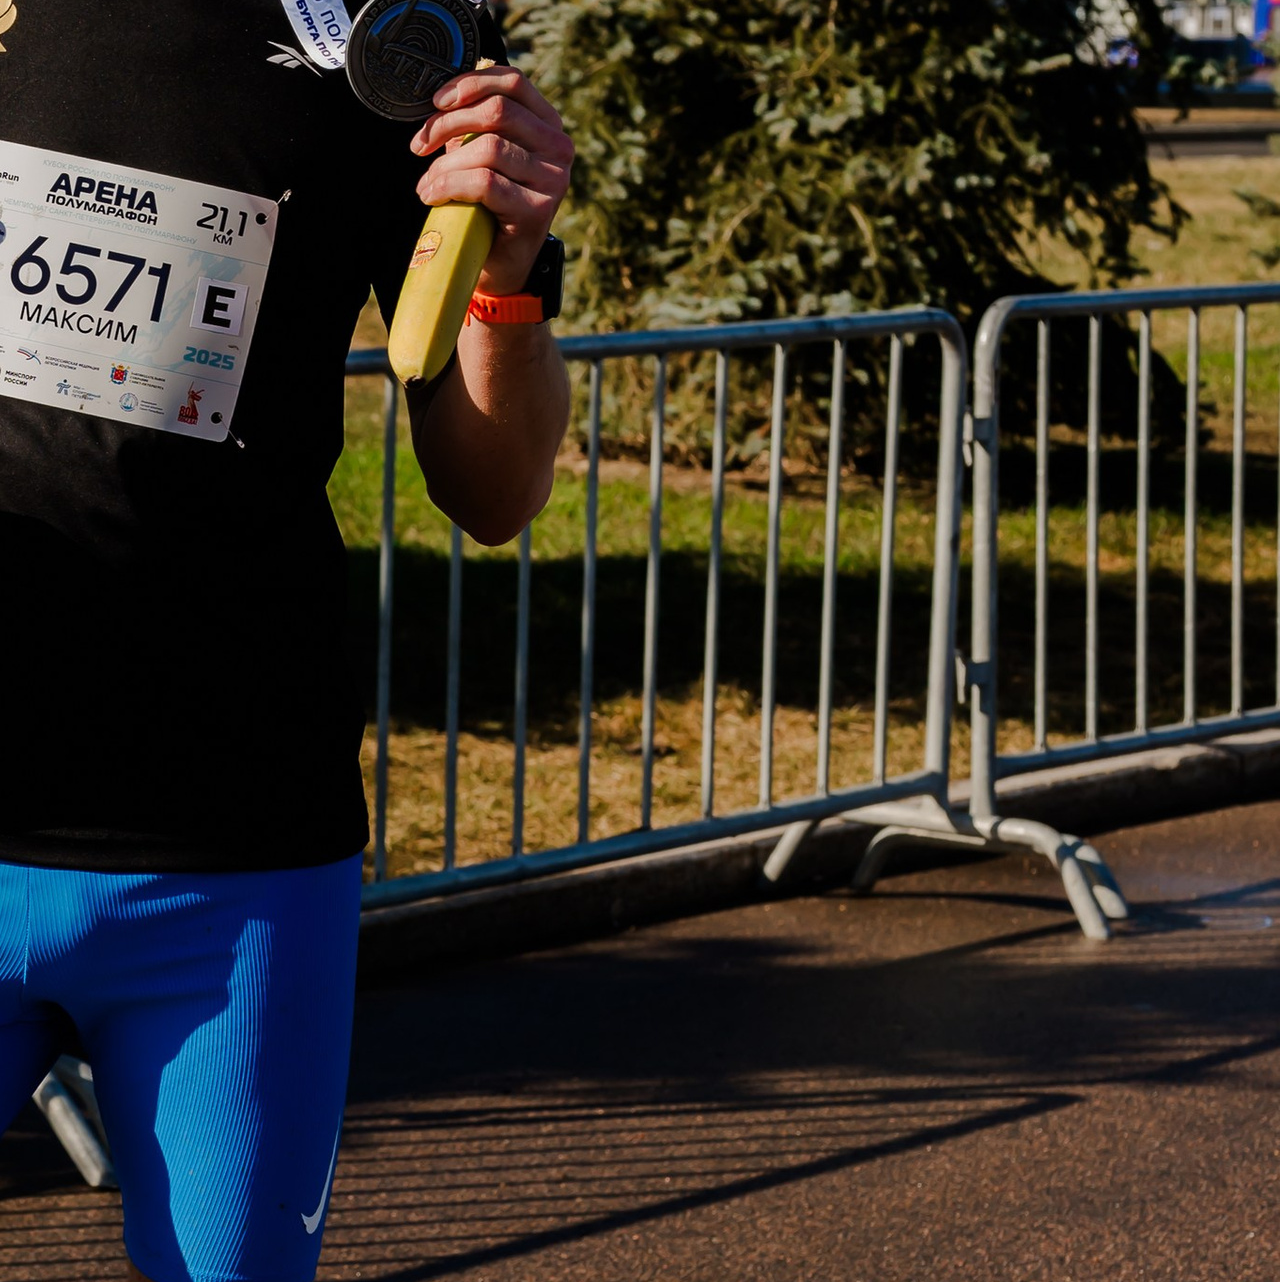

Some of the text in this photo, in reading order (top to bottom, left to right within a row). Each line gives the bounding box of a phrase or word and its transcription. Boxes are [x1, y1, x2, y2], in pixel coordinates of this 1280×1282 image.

[321, 9, 346, 54] ПОЛ
[316, 42, 331, 57] ПО
[368, 92, 393, 112] 2025
[43, 159, 69, 170] КУБОК
[69, 164, 99, 178] РОССИИ
[112, 173, 176, 193] ПОЛУМАРАФОНУ
[46, 193, 158, 226] ПОЛУМАРАФОН
[49, 172, 158, 215] АРЕНА
[196, 202, 248, 237] 21,1
[213, 233, 234, 246] КМ
[10, 235, 172, 323] 6571
[20, 301, 138, 345] МАКСИМ
[183, 346, 236, 371] 2025
[4, 377, 28, 386] РОССИИ
[5, 370, 37, 381] МИНСПОРТ
